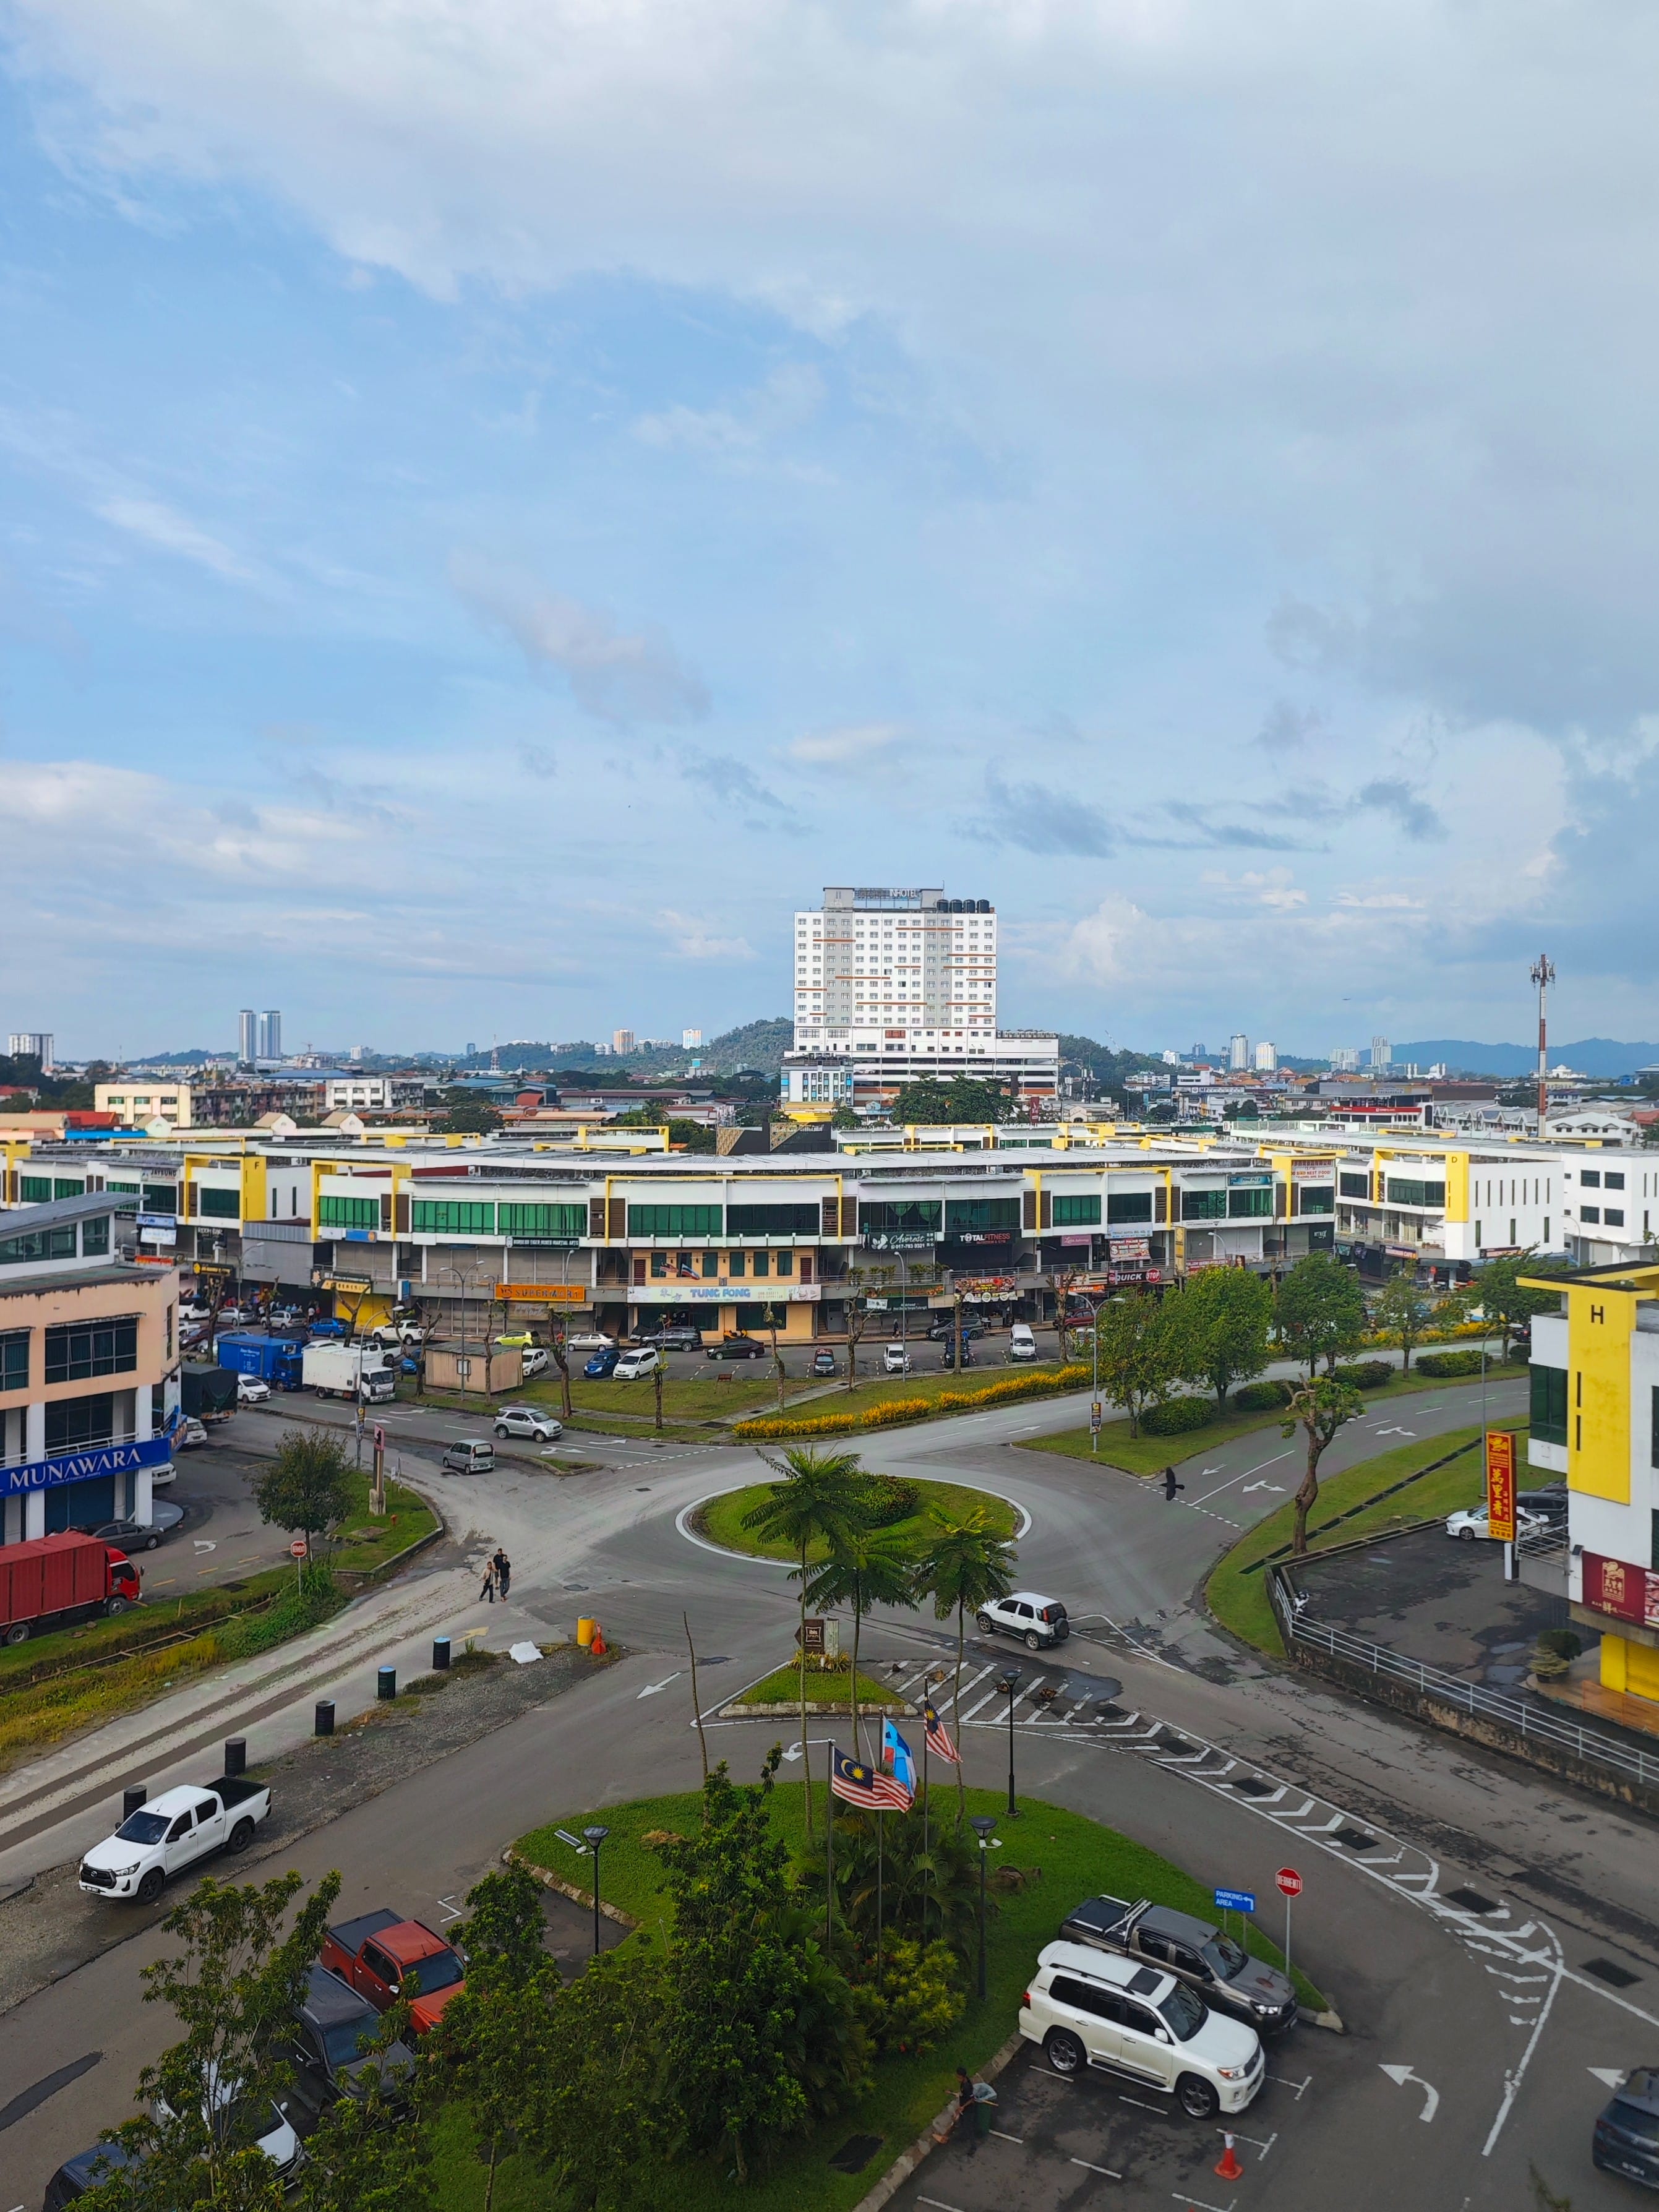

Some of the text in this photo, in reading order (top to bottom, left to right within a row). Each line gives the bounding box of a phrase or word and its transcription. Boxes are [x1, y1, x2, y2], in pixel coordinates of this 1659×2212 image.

[690, 1288, 720, 1298] TUNG
[722, 1288, 751, 1298] FONG
[1590, 1304, 1604, 1324] H
[10, 1447, 142, 1490] MUNAWARA
[1276, 1874, 1301, 1890] BERHENTI
[1215, 1890, 1243, 1901] PARKING
[1215, 1898, 1233, 1907] AREA
